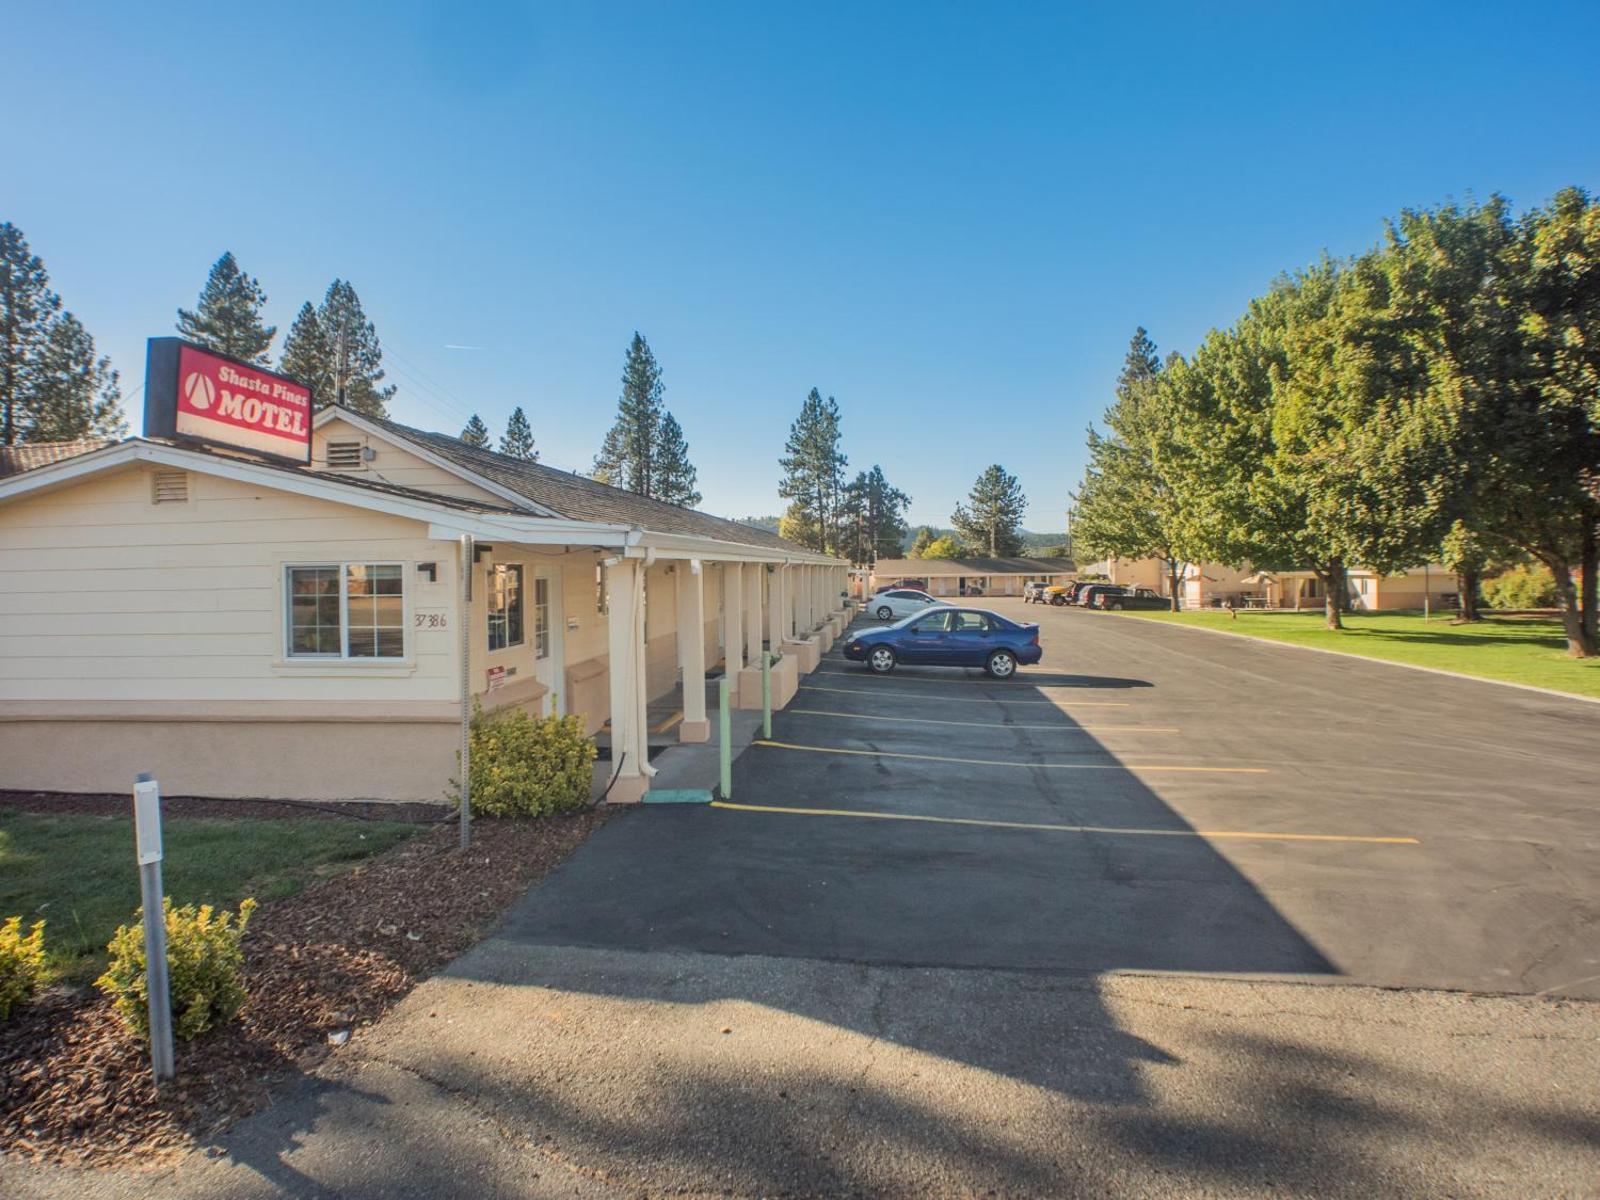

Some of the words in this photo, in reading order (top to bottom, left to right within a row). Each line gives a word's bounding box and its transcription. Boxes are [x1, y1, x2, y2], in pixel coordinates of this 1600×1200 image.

[218, 366, 270, 395] Shasta
[272, 383, 307, 407] Pines
[216, 389, 307, 437] MOTEL
[414, 614, 447, 628] 37386
